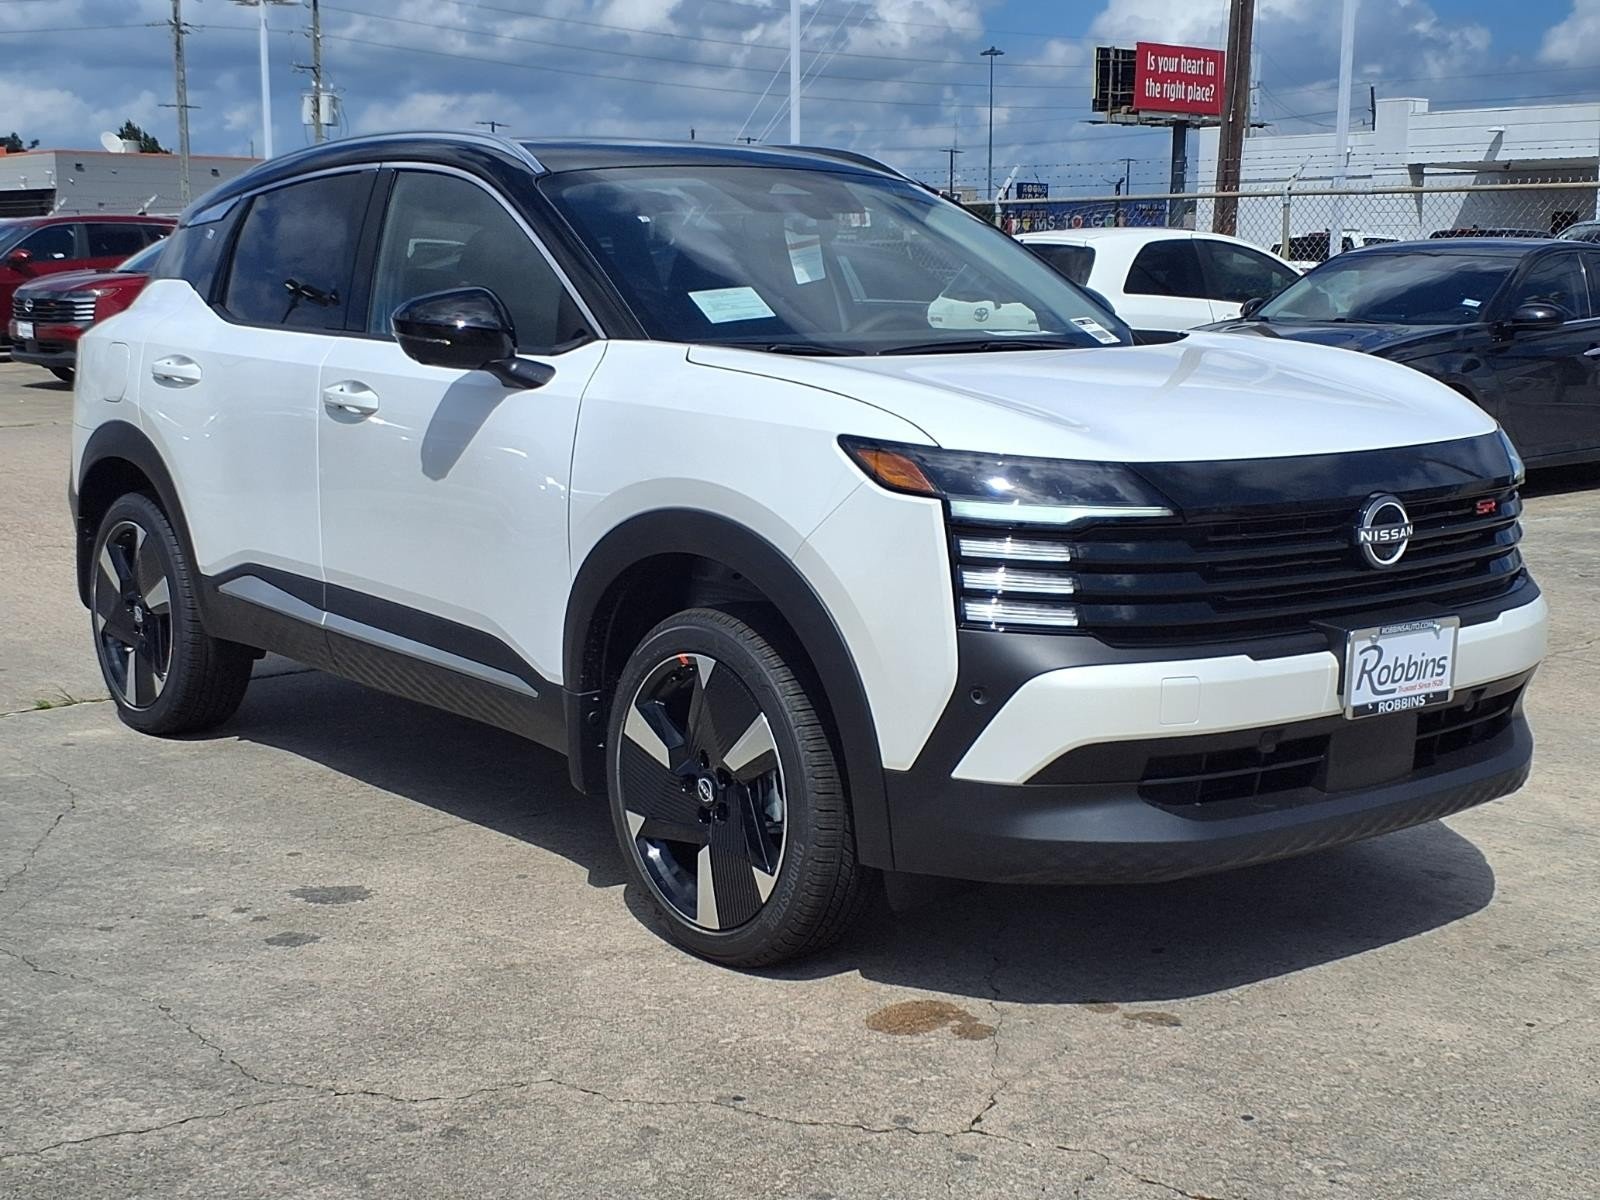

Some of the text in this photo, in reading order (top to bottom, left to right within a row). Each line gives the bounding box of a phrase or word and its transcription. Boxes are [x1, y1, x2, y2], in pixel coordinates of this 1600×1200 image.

[1147, 51, 1215, 76] Is your heart in
[1145, 78, 1214, 103] the right place?
[1475, 498, 1497, 515] SR
[1360, 524, 1413, 542] NISSAN
[1356, 645, 1448, 695] Robbins
[1378, 694, 1426, 713] ROBBINS
